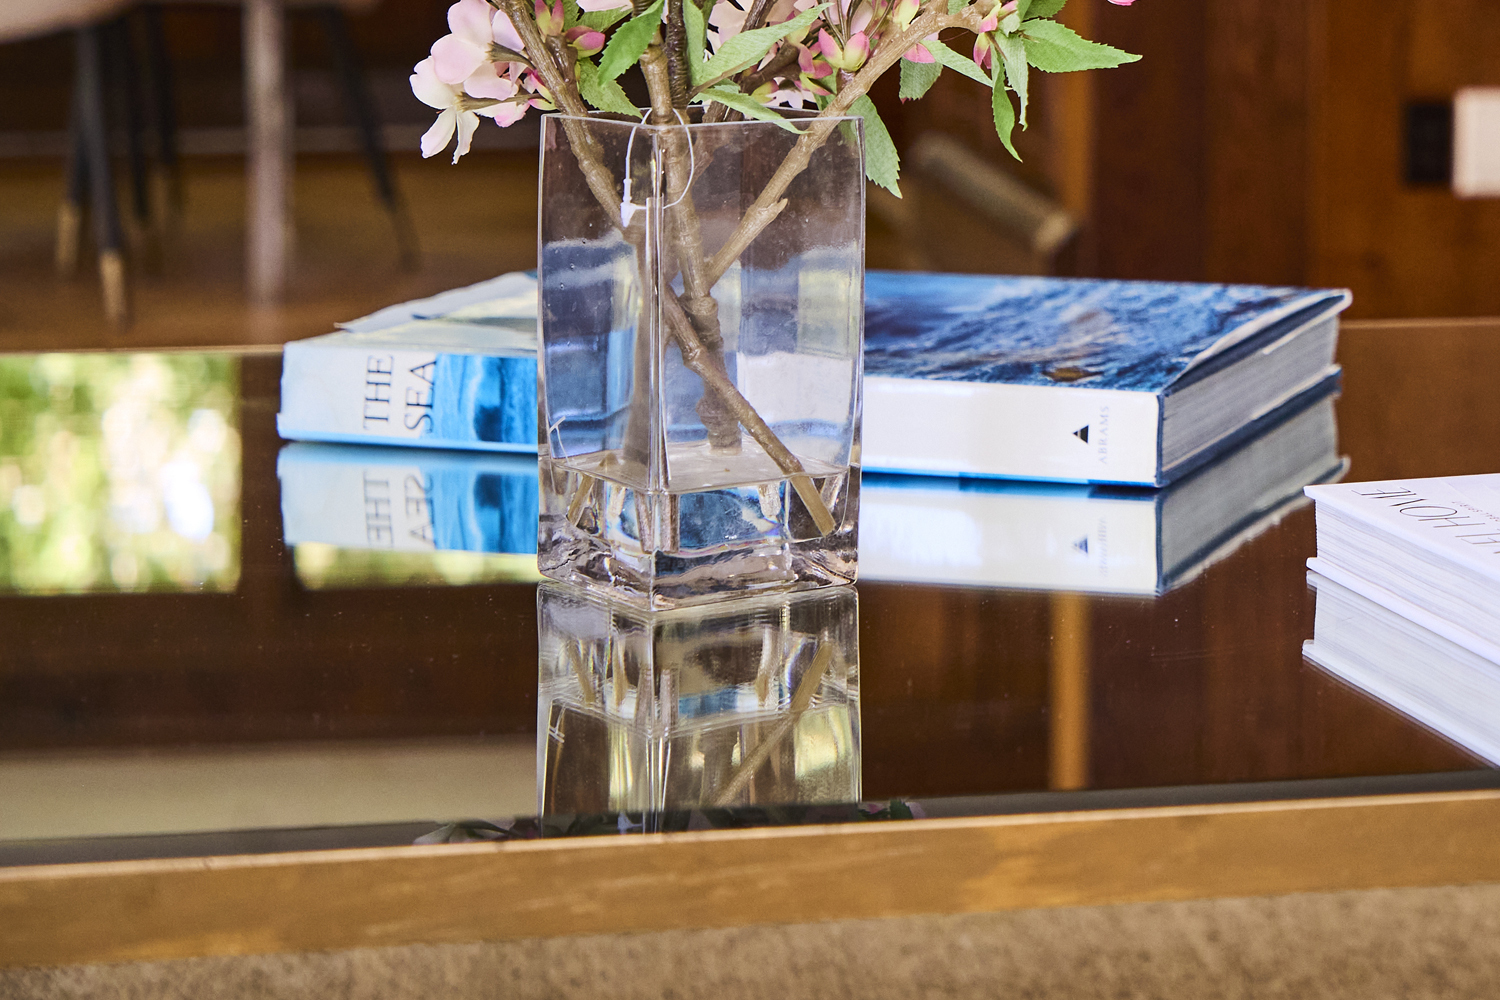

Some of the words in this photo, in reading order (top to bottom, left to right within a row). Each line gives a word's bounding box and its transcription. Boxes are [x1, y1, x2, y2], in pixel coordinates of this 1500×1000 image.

[363, 355, 394, 431] THE
[404, 360, 437, 435] SEA
[1098, 405, 1110, 465] ABRAMS
[1352, 486, 1486, 528] HOME
